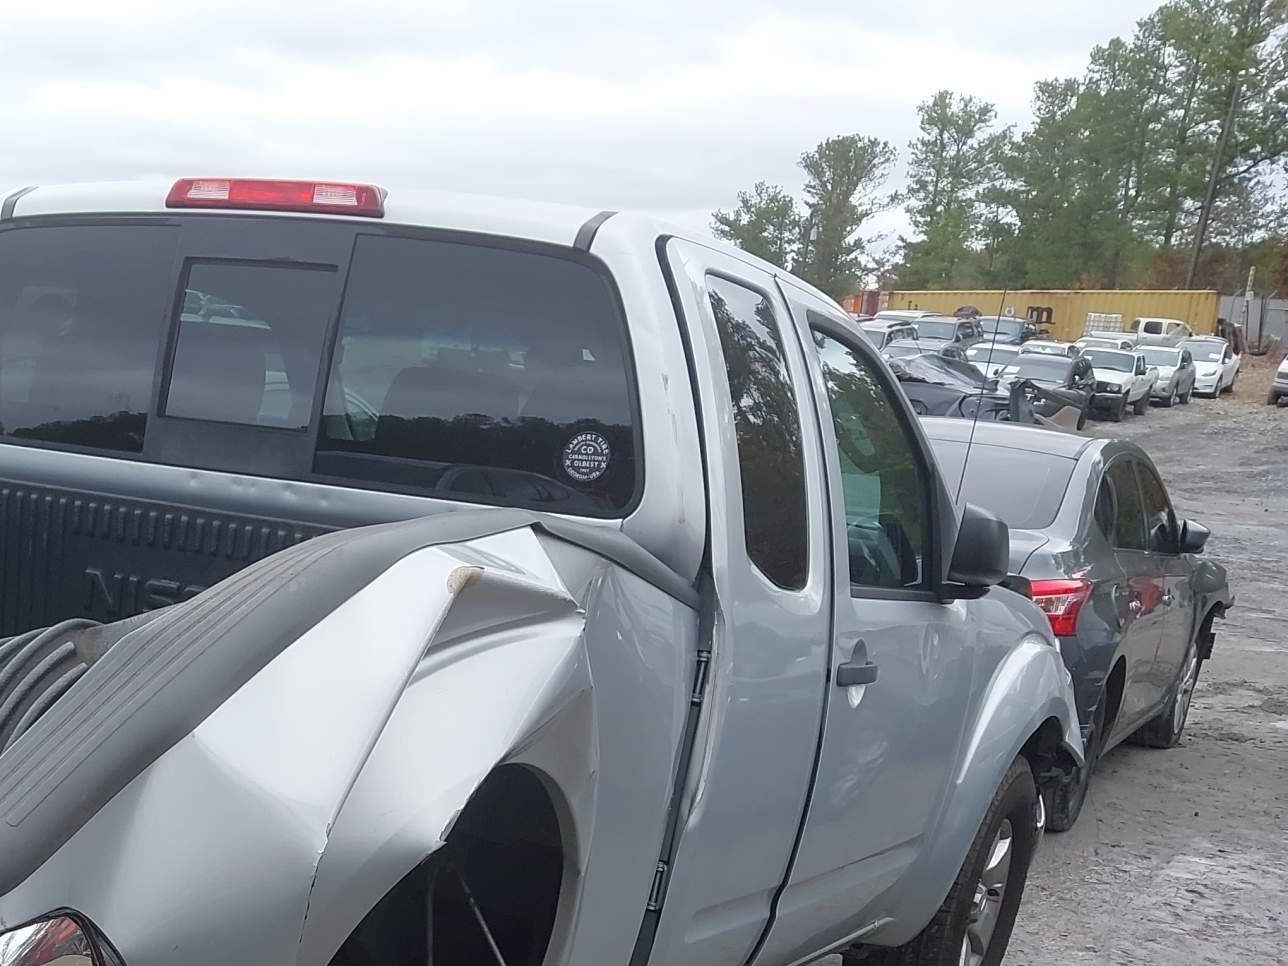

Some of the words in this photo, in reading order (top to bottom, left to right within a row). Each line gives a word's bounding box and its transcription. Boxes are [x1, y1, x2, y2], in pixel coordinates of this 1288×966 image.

[566, 434, 596, 453] LAMBERT
[597, 436, 608, 454] TIRE
[581, 446, 594, 454] CO
